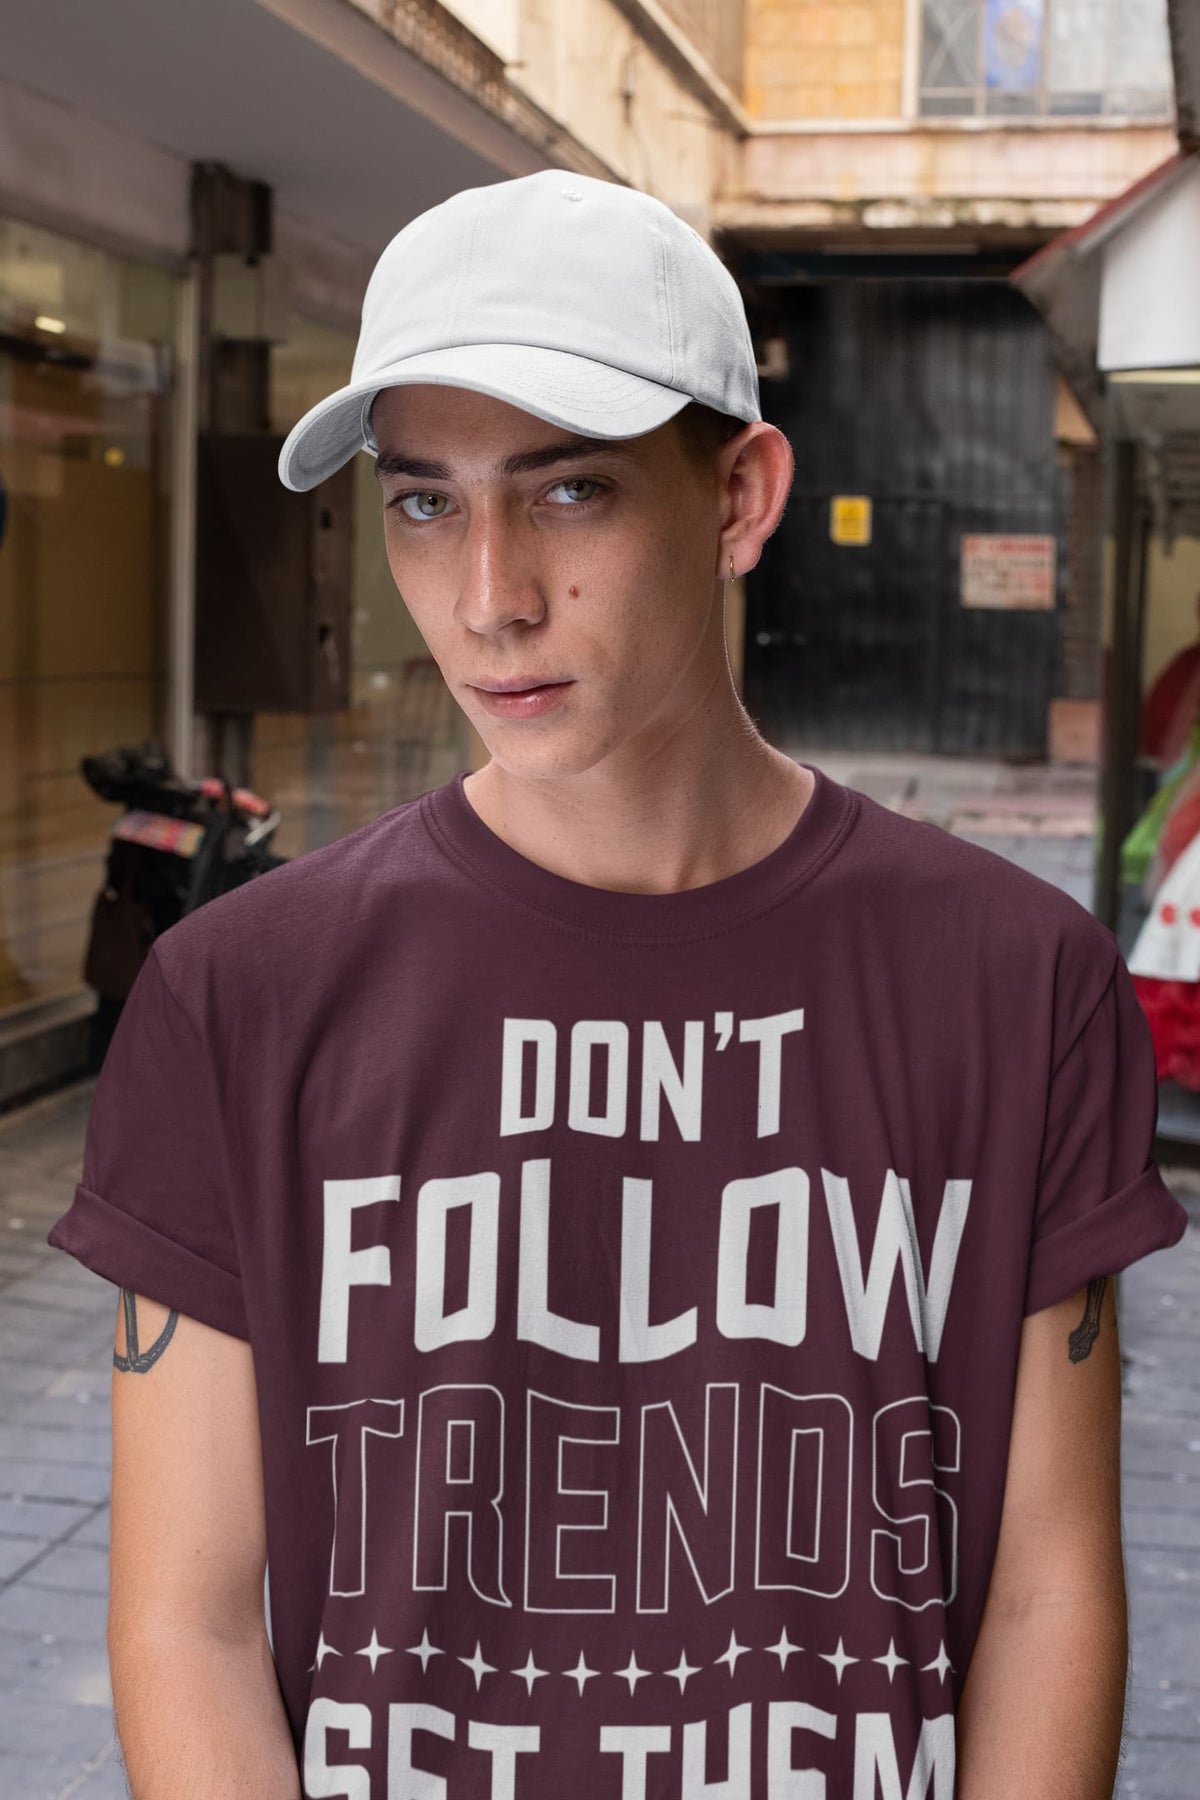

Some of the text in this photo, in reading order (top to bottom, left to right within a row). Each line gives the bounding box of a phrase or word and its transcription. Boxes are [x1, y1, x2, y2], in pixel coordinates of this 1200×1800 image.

[500, 1008, 804, 1141] DON'T
[317, 1159, 973, 1364] FOLLOW
[305, 1382, 961, 1614] TRENDS
